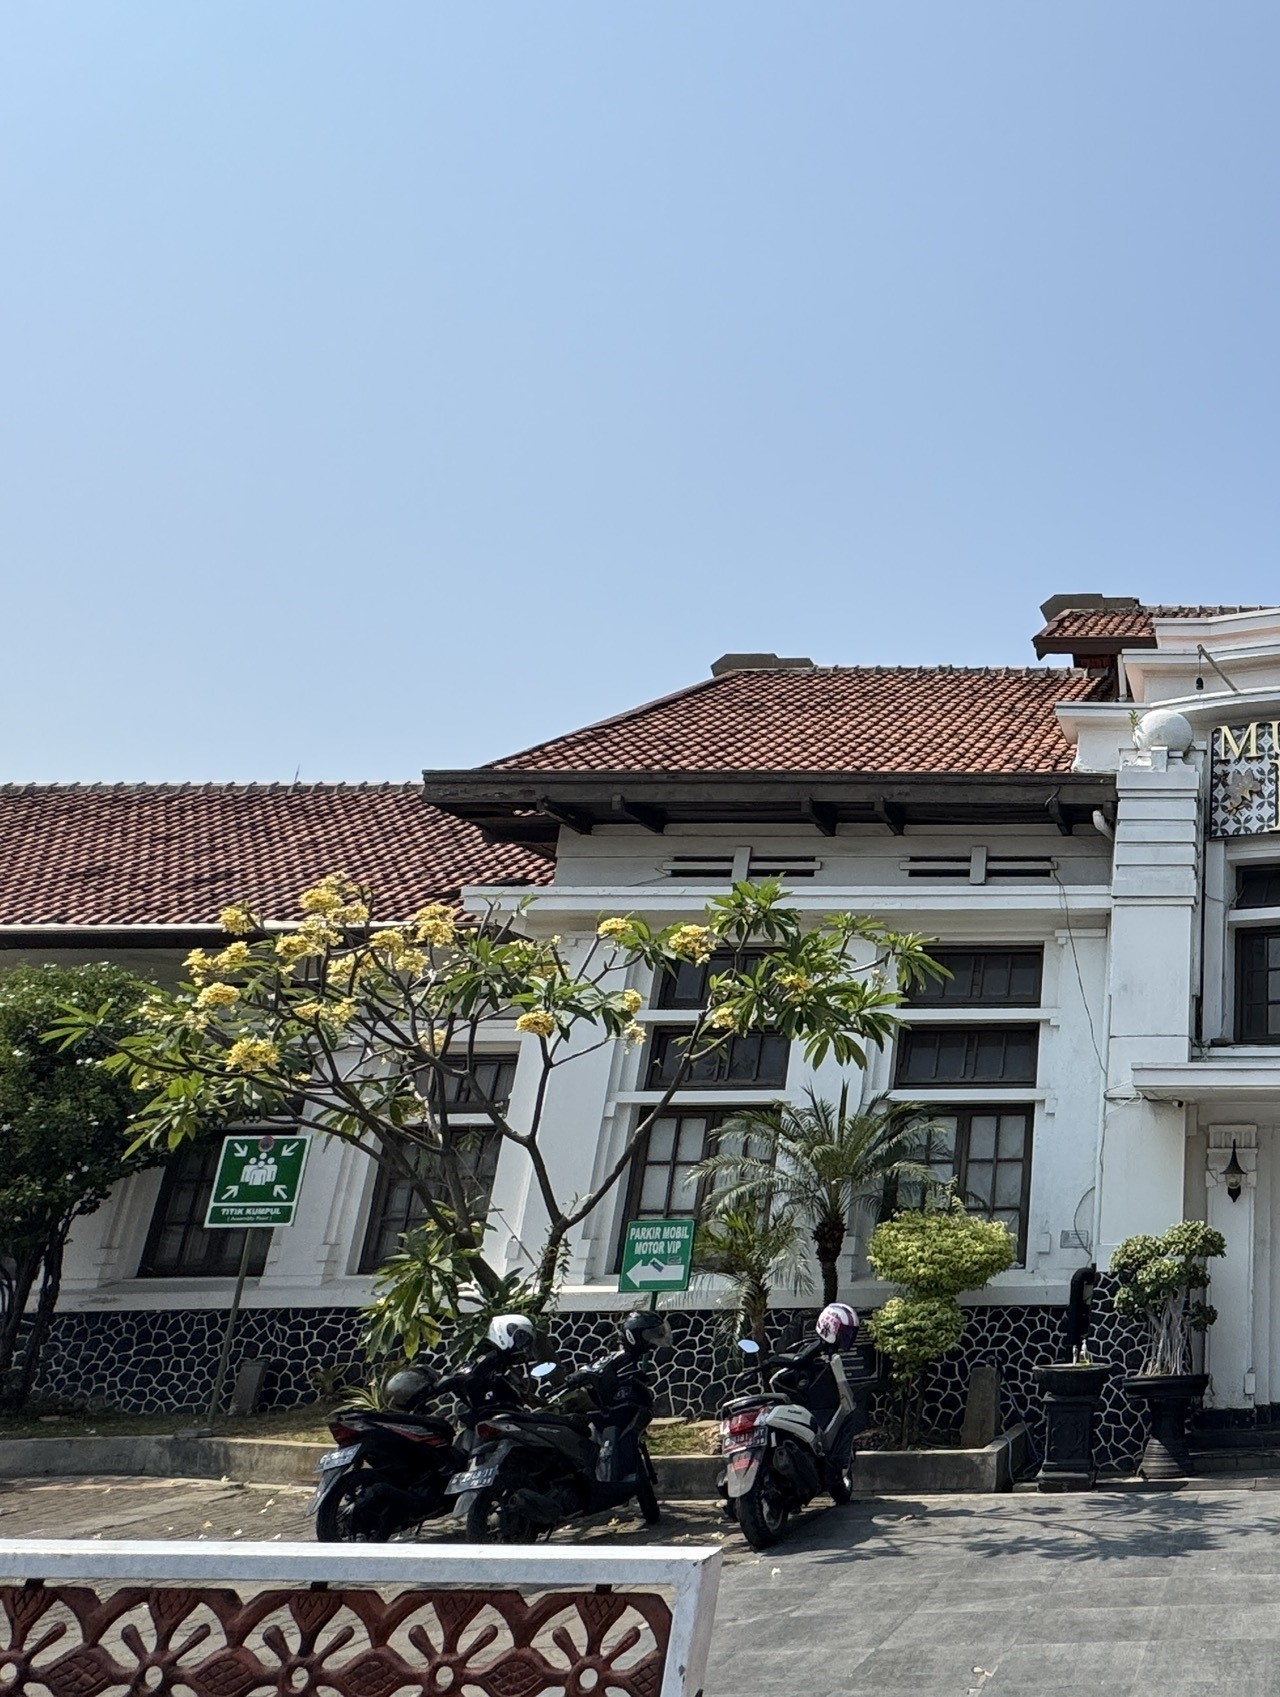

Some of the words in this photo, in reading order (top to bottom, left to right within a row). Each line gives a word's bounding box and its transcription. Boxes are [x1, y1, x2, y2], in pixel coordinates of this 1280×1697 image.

[245, 1207, 281, 1215] KUMPUL
[630, 1227, 661, 1240] PARKIR
[662, 1226, 690, 1239] MOBIL
[634, 1241, 665, 1255] MOTOR
[667, 1240, 682, 1254] VIP
